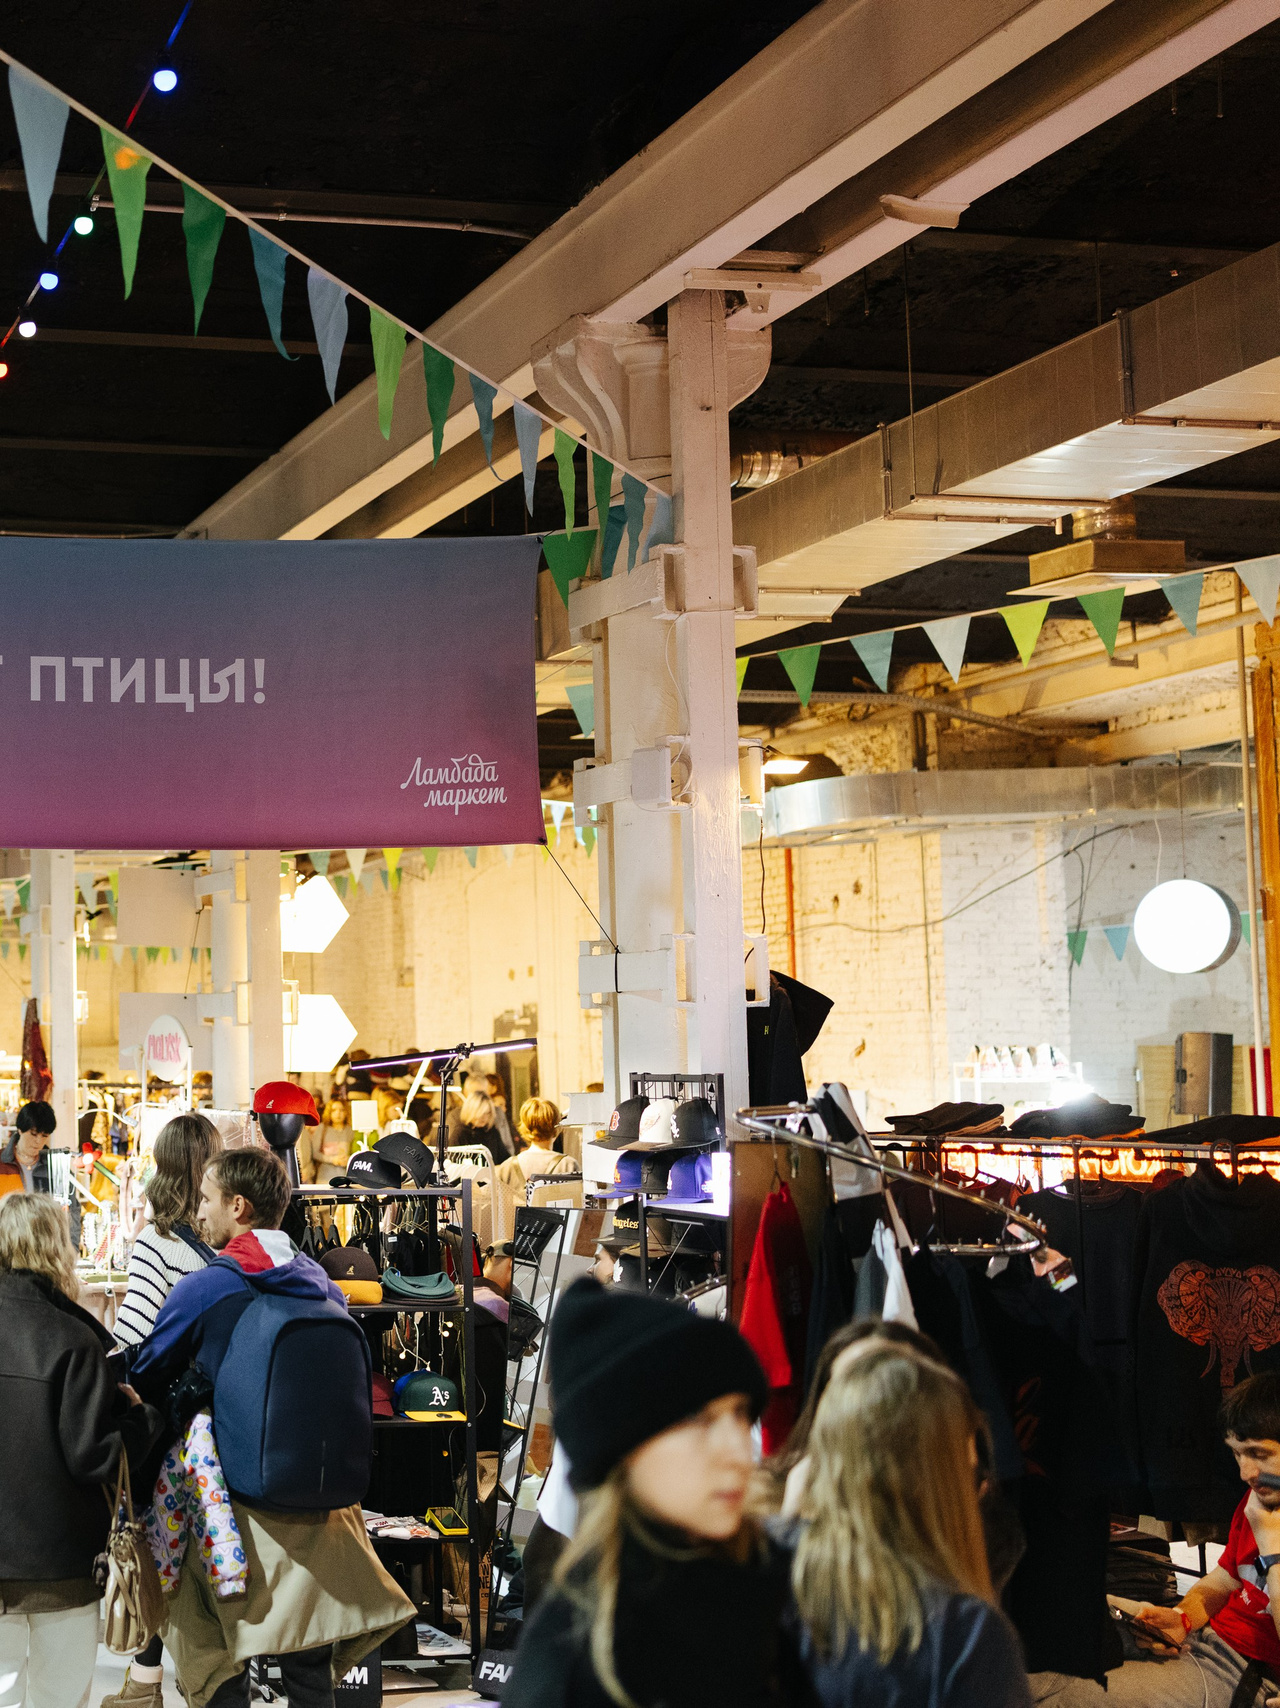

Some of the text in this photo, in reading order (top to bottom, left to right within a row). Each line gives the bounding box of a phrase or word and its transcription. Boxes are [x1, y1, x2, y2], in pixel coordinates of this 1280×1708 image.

[30, 655, 266, 713] ПТИЦЫ!
[400, 753, 498, 790] Ламбада
[423, 787, 508, 816] маркет
[352, 1160, 373, 1173] FAM.
[428, 1386, 450, 1406] A's
[341, 1666, 369, 1685] AM
